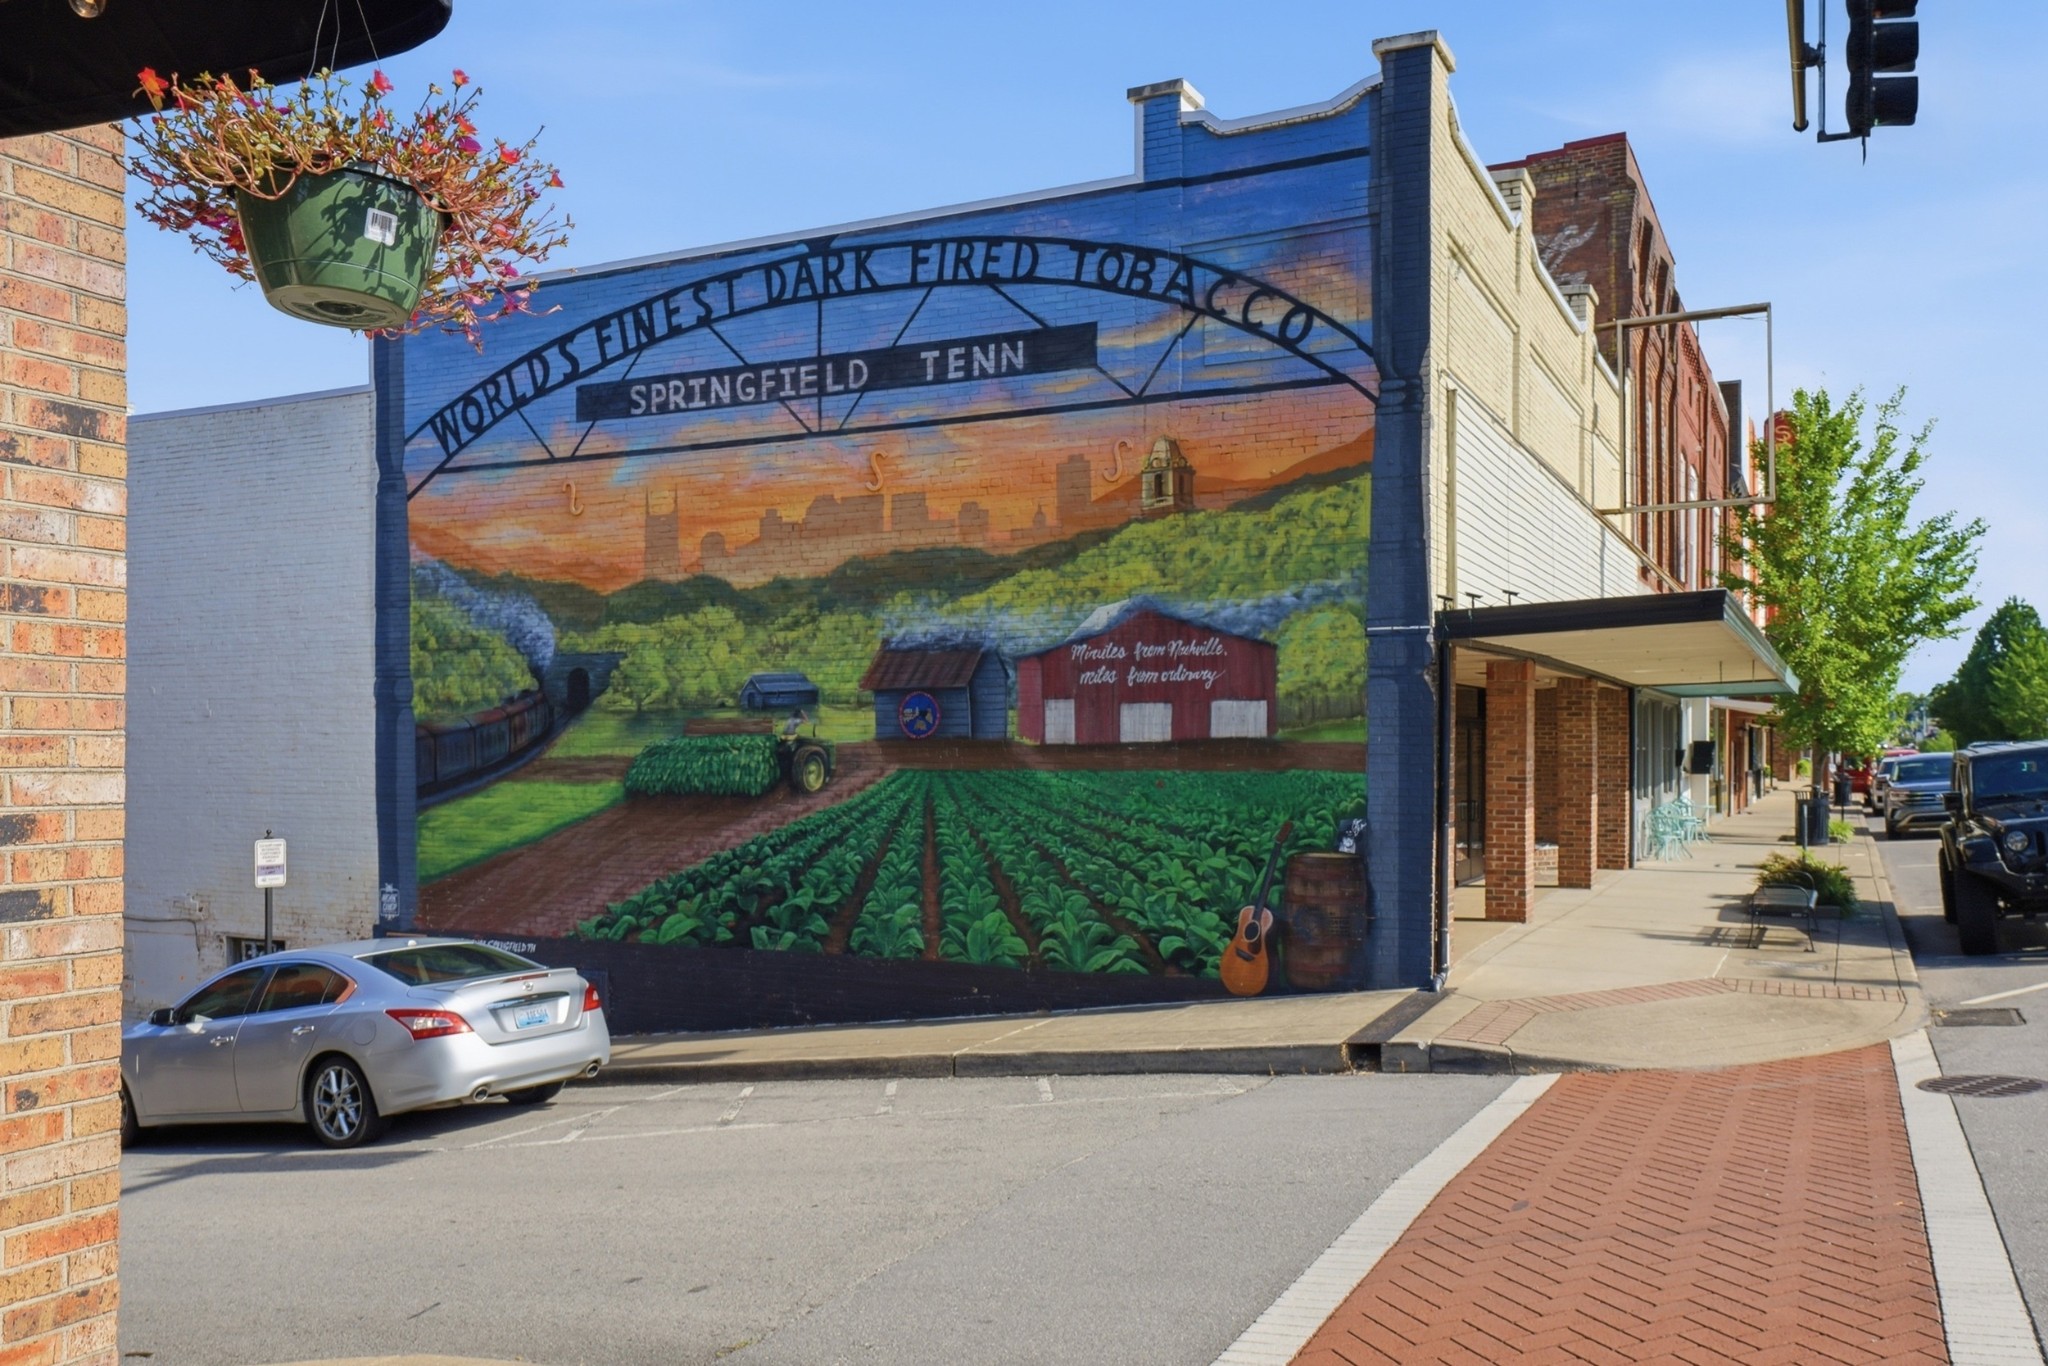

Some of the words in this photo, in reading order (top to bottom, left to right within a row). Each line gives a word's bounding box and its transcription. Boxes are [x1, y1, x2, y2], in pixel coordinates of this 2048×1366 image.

[429, 334, 580, 457] WORLDS
[595, 275, 748, 365] FINEST
[763, 250, 879, 301] DARK
[910, 240, 1040, 283] FIRED
[1069, 243, 1314, 346] TOBACCO
[630, 358, 869, 417] SPRINGFIELD
[920, 340, 1025, 382] TENN
[1071, 642, 1127, 664] Minutes
[1134, 641, 1164, 661] from
[1080, 666, 1117, 685] miles
[1127, 666, 1158, 687] from
[1161, 664, 1225, 689] ordinary
